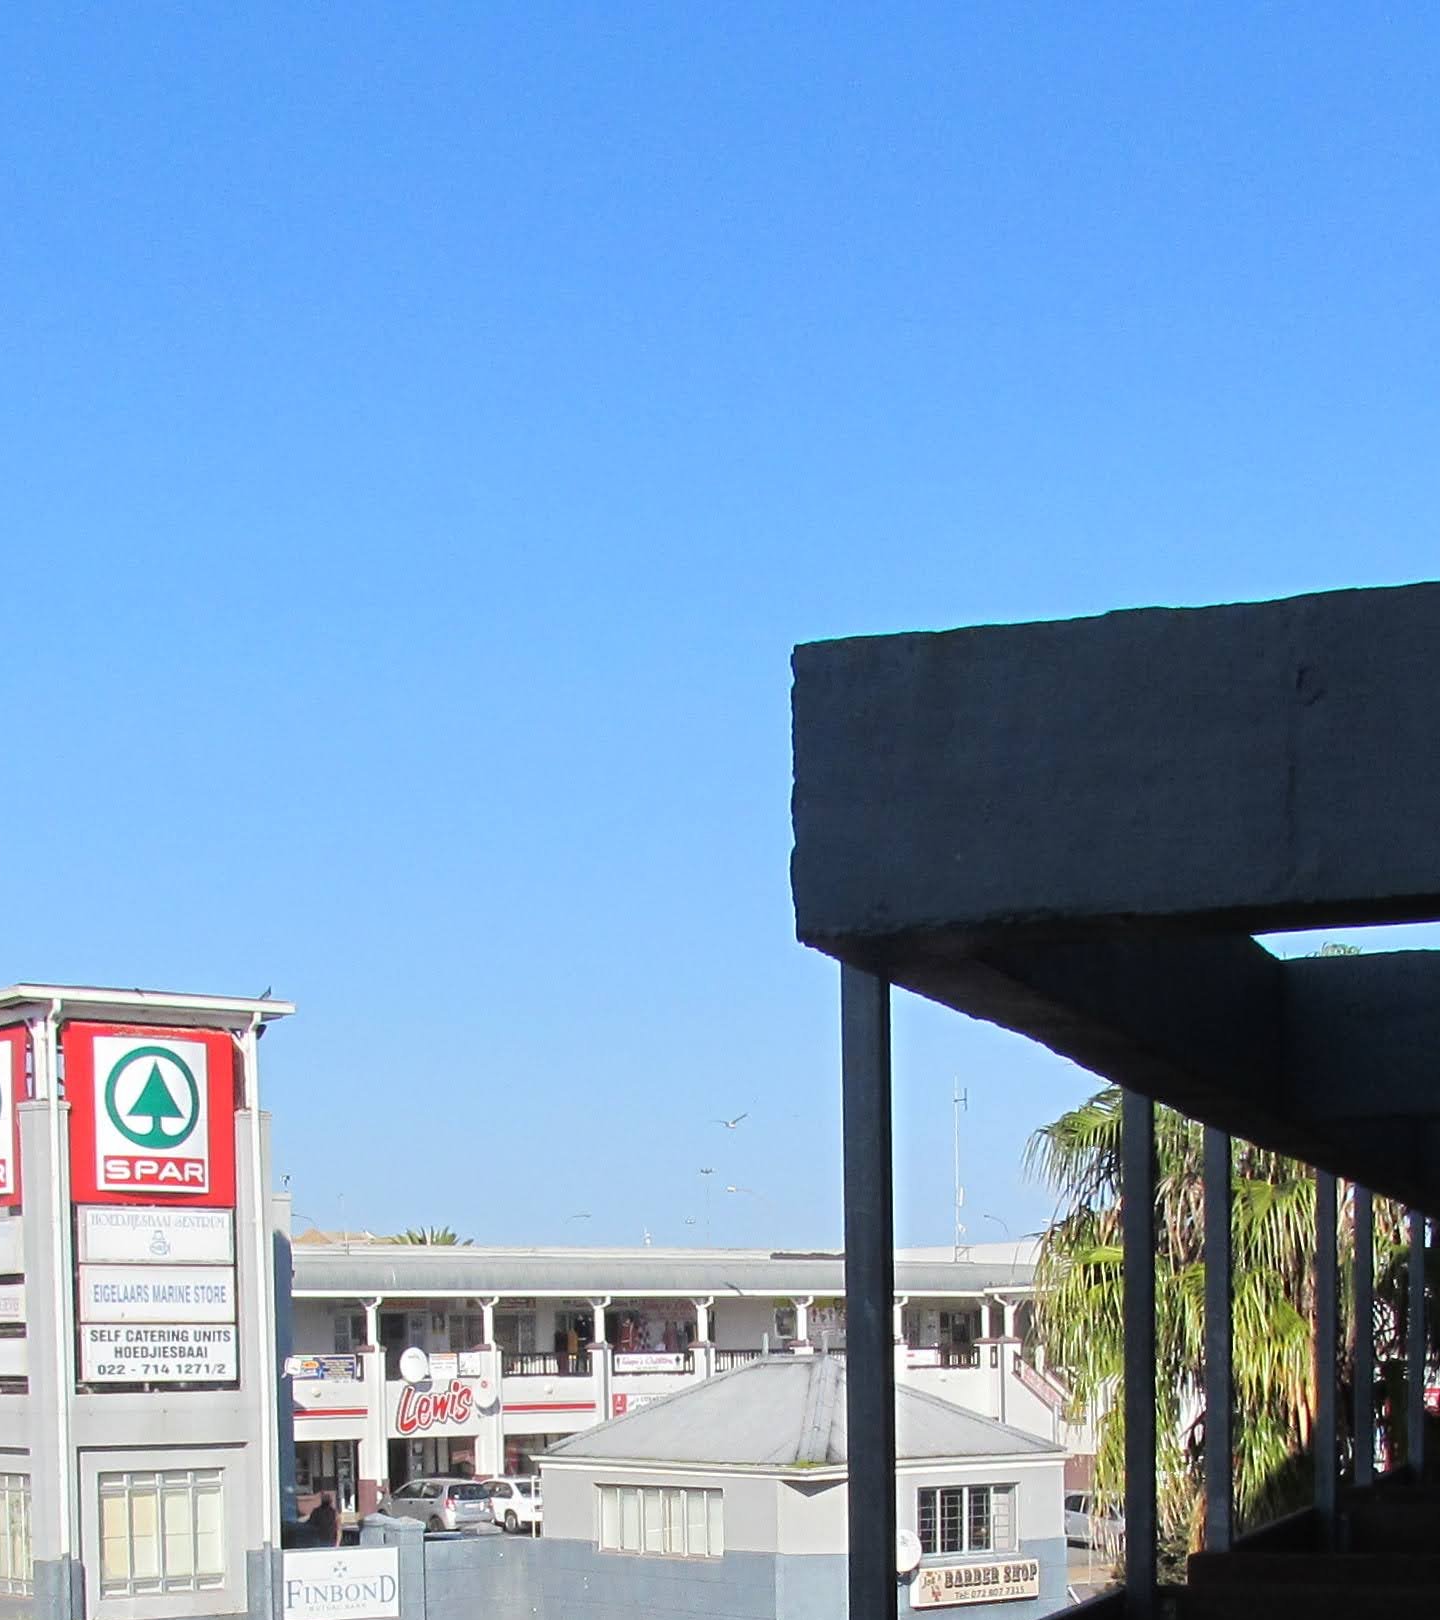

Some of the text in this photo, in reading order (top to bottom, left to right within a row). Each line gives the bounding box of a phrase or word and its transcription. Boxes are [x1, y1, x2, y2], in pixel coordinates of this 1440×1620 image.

[105, 1159, 204, 1183] SPAR
[93, 1284, 227, 1304] EIGELAARS MARINE STORE
[90, 1330, 232, 1343] SELF CATERING UNITS
[114, 1346, 209, 1359] HOEDJIESBAAI
[97, 1364, 126, 1376] 022
[142, 1364, 170, 1375] 714
[175, 1363, 227, 1375] 1271/2
[397, 1378, 474, 1434] Lewis
[944, 1567, 1000, 1589] BARBER
[1003, 1563, 1037, 1583] SHOP
[286, 1574, 396, 1609] FINBOND
